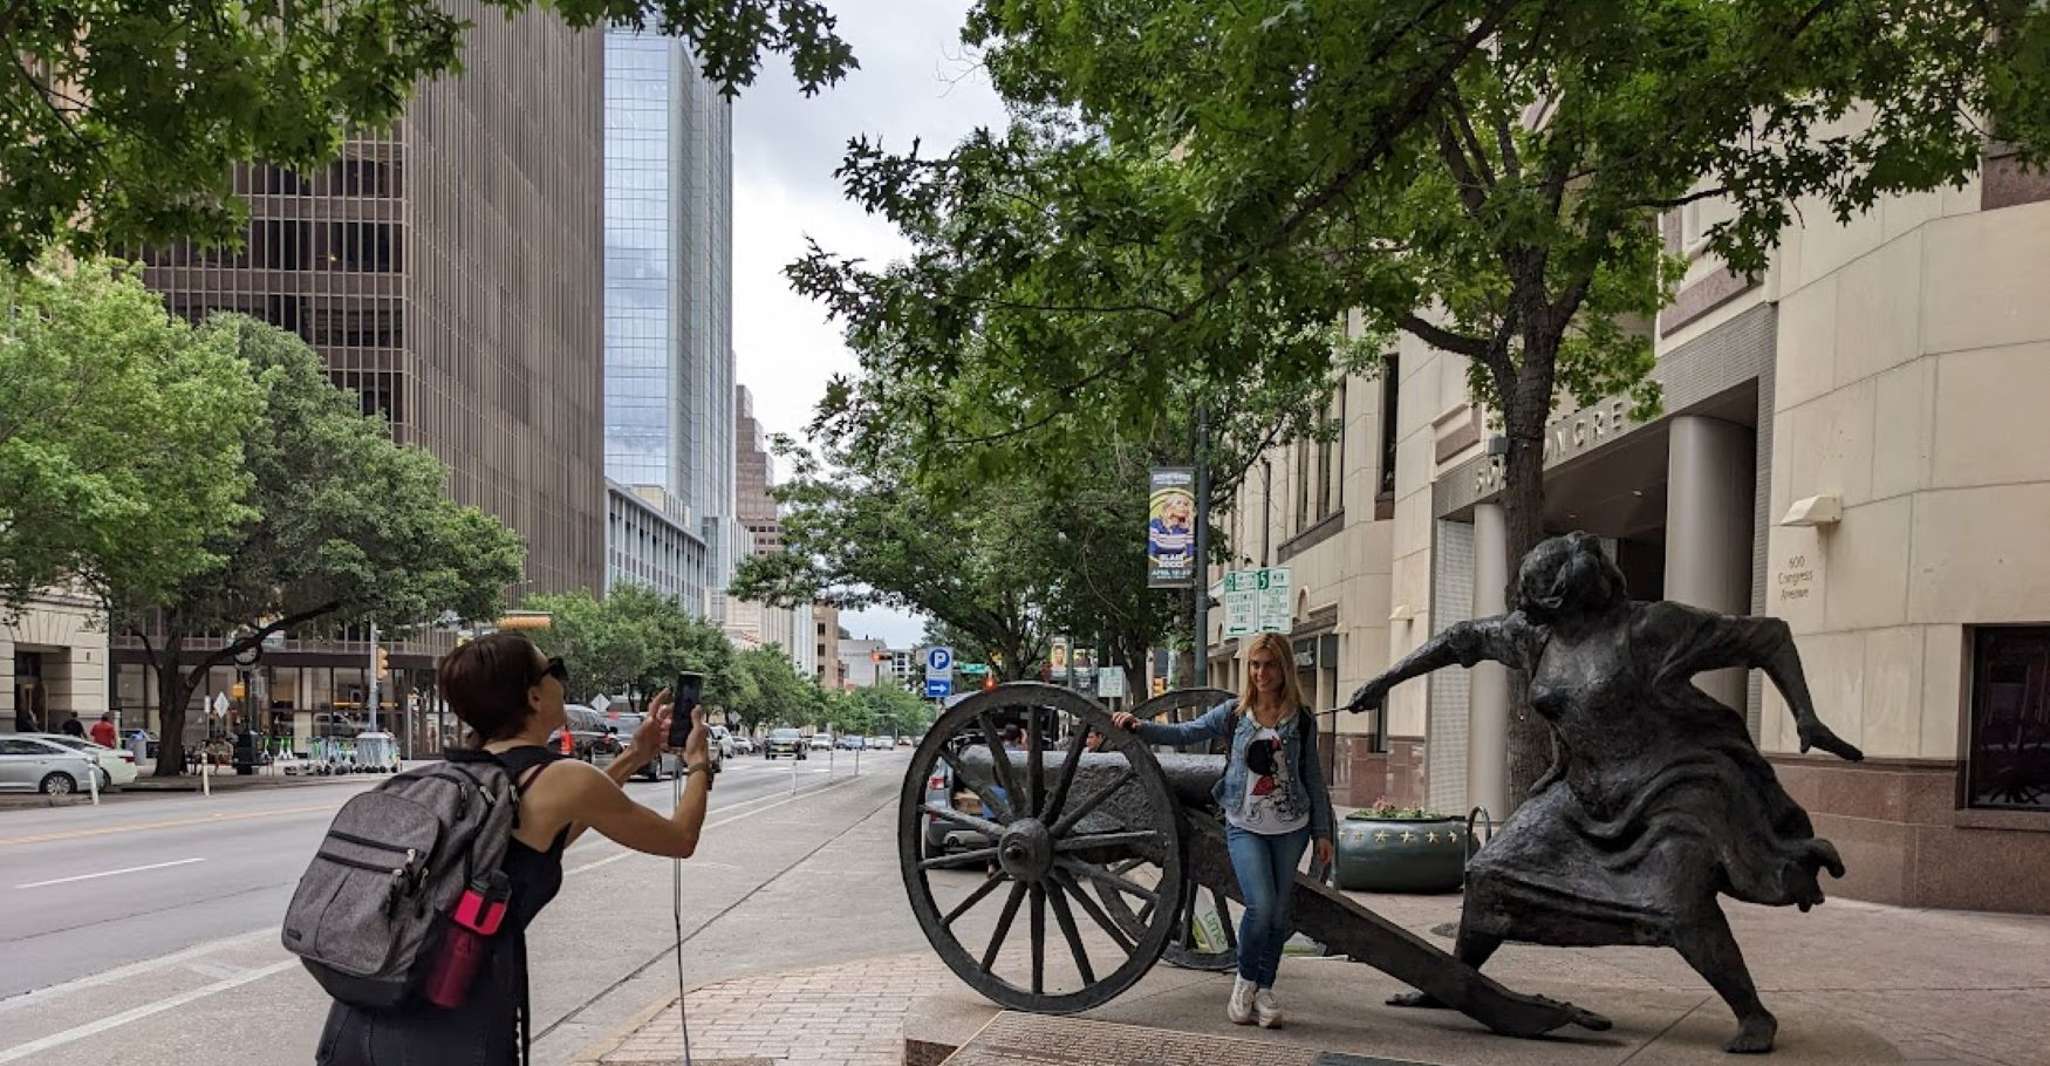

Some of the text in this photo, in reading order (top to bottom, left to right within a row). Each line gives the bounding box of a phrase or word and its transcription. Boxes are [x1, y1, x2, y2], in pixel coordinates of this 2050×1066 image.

[1260, 571, 1268, 589] 5
[1777, 570, 1813, 586] Congress
[1780, 588, 1809, 601] Avenue
[934, 652, 946, 668] P
